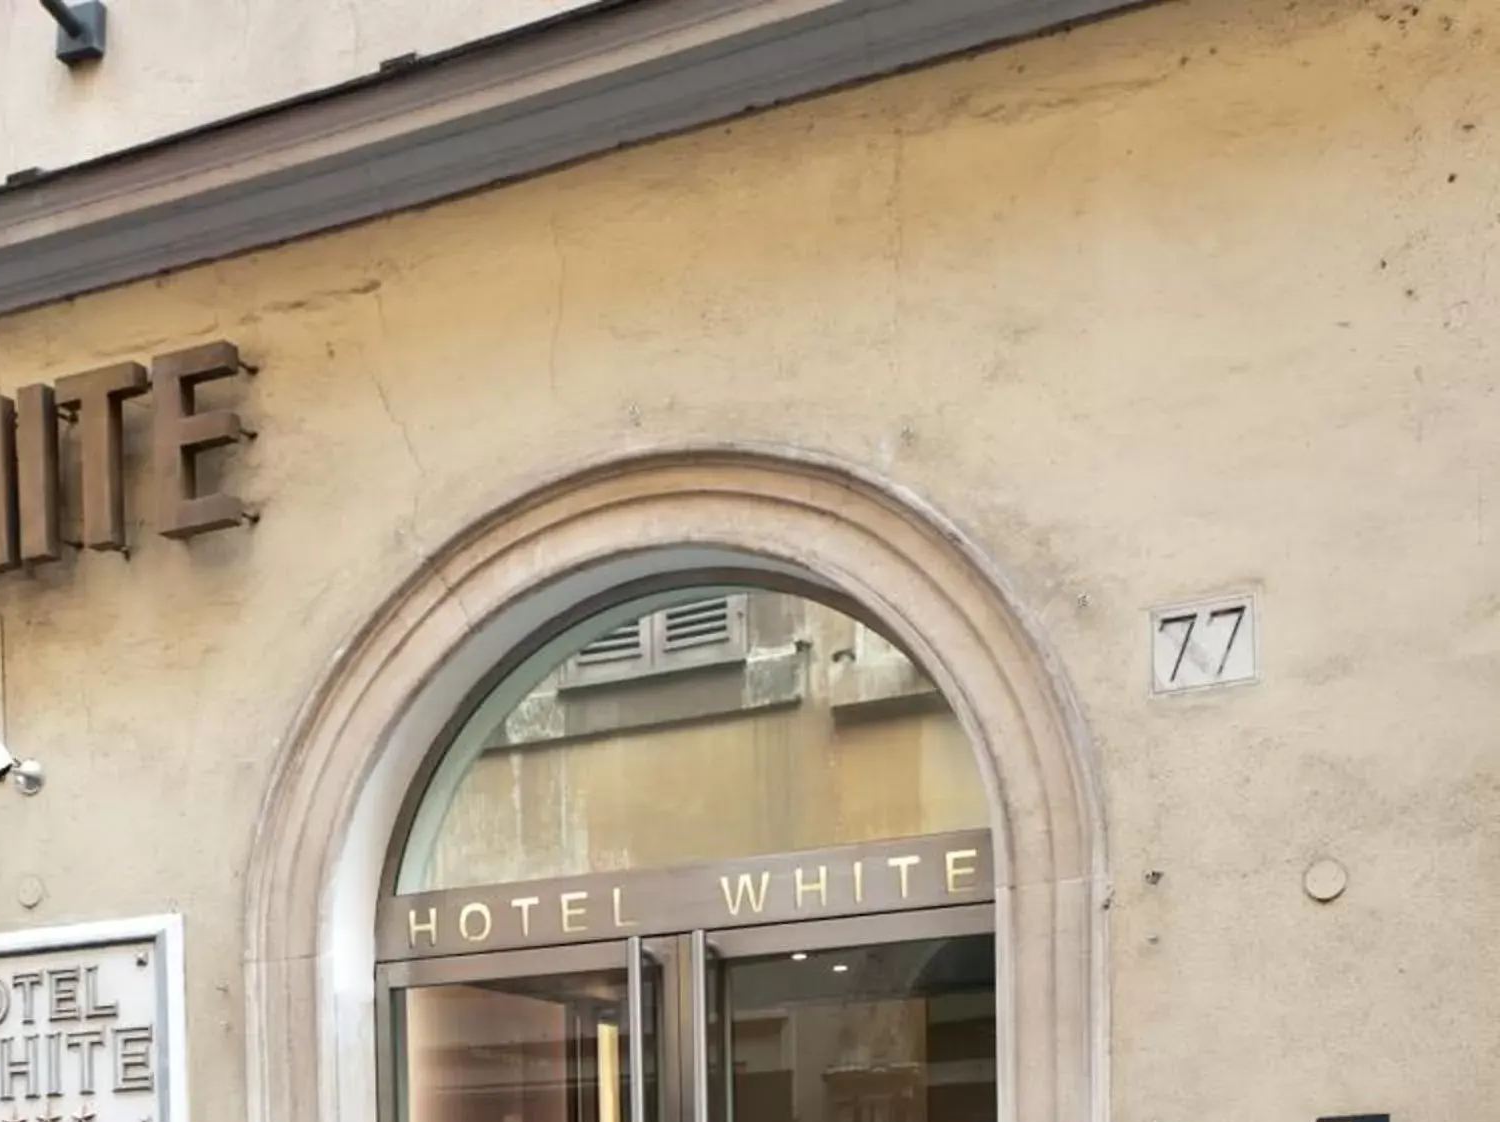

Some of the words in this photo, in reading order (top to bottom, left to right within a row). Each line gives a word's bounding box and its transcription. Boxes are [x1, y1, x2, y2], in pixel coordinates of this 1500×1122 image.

[1158, 605, 1246, 682] 77
[408, 886, 640, 950] HOTEL
[720, 848, 979, 916] WHITE
